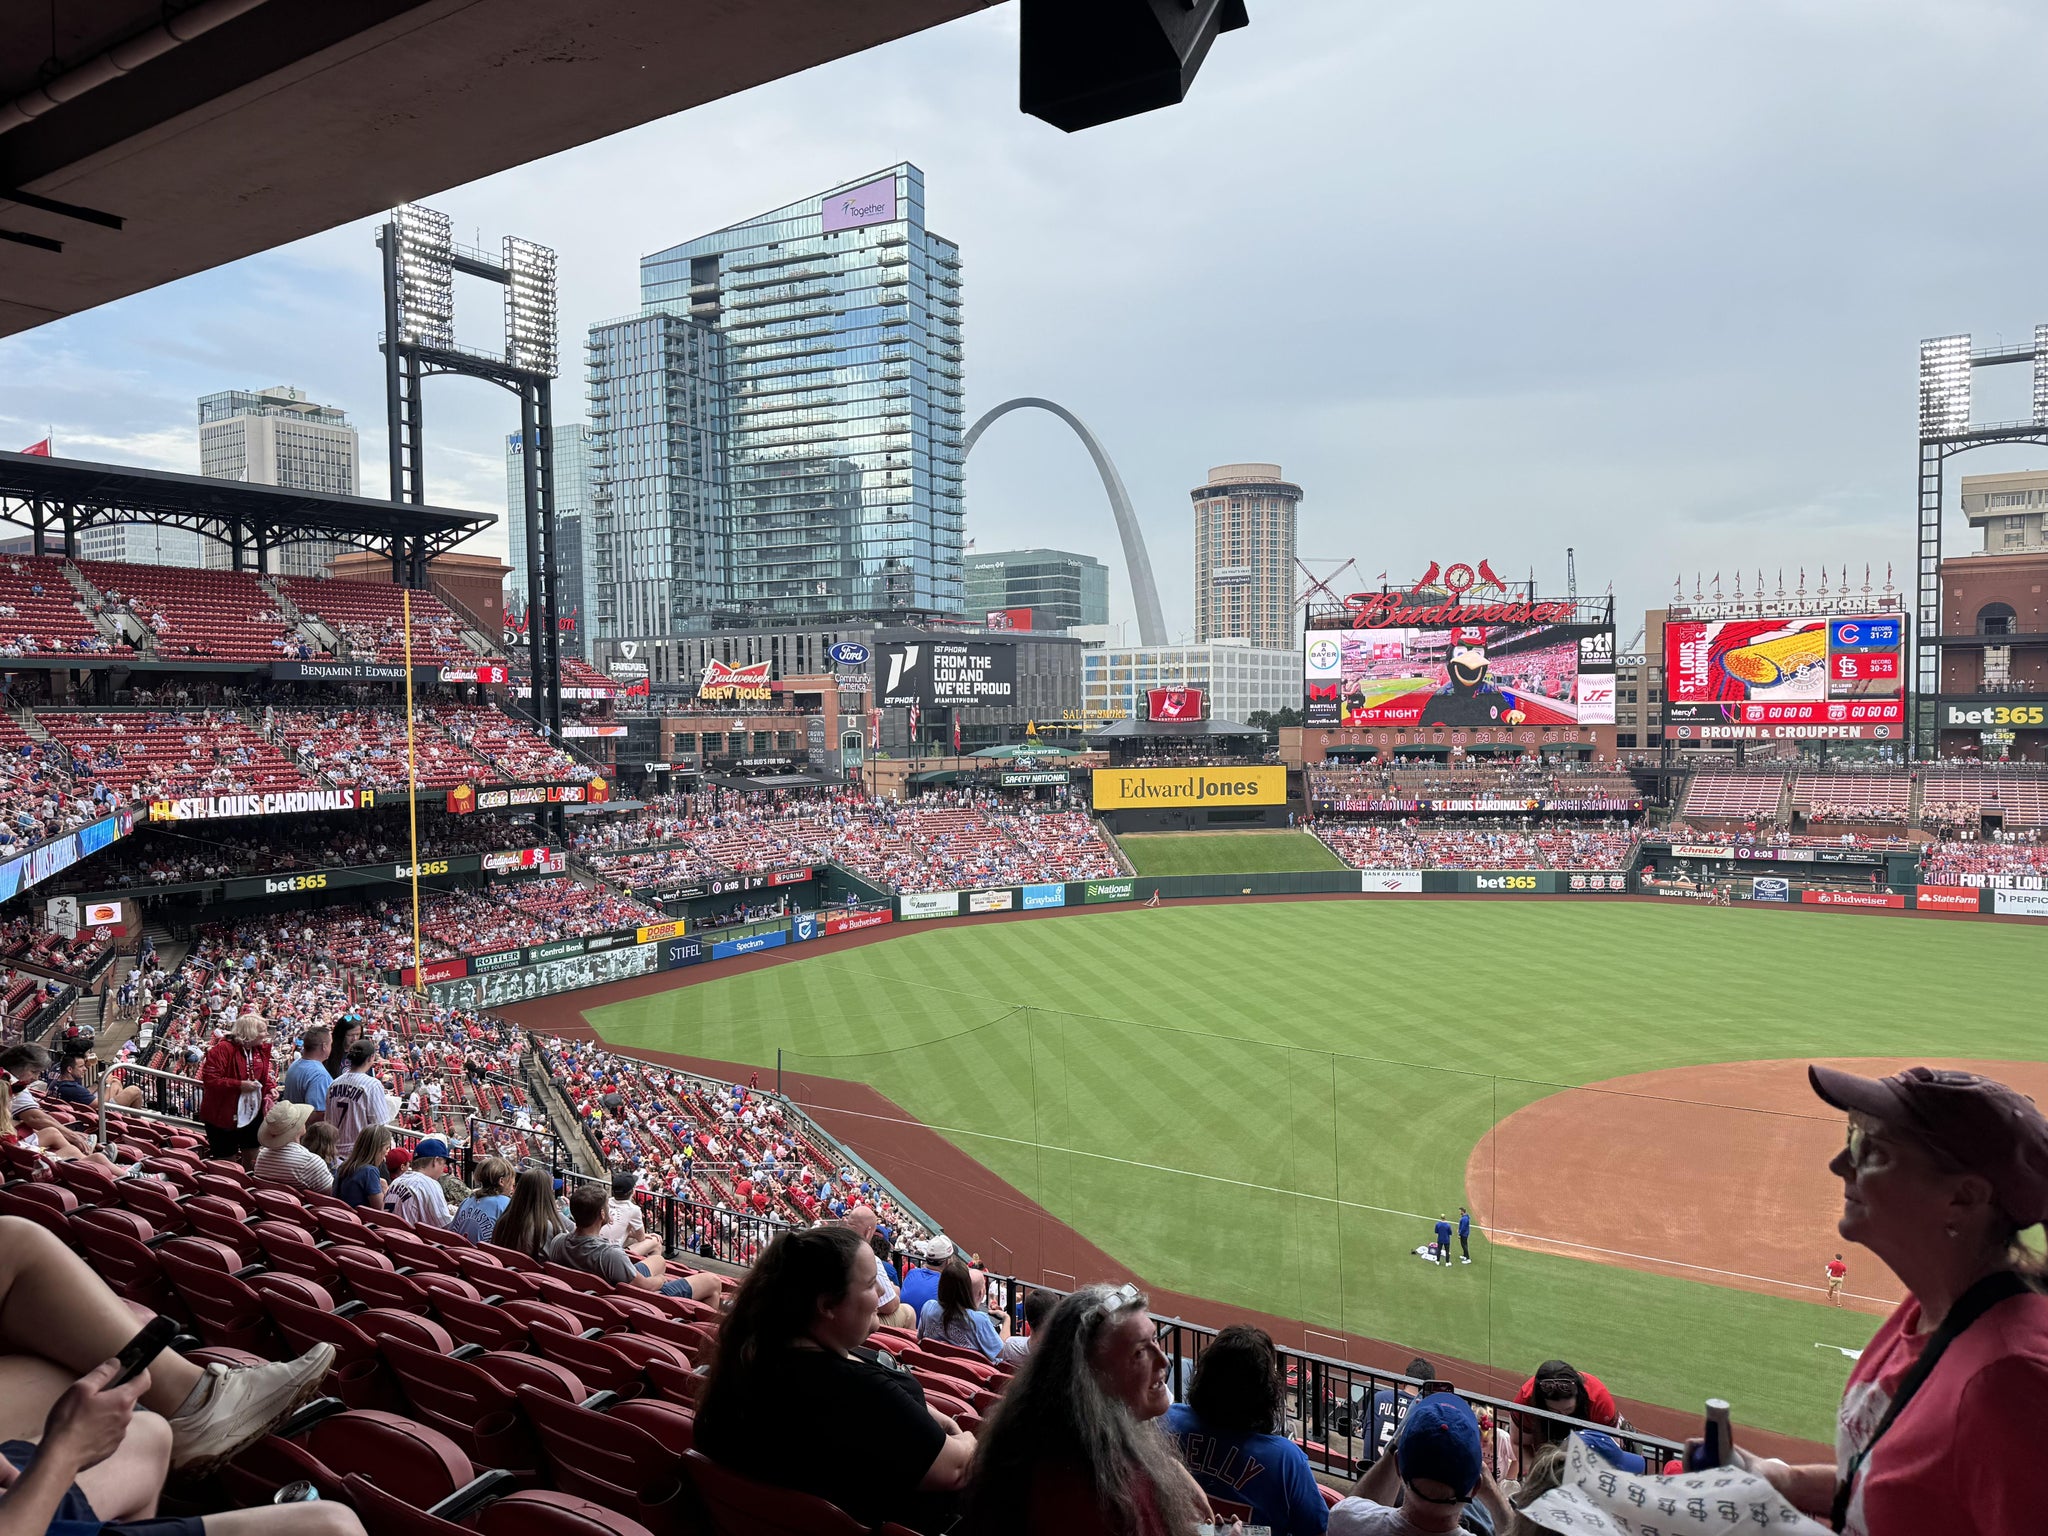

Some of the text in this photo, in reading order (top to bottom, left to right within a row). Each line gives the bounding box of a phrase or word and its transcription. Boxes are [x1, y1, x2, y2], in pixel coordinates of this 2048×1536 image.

[850, 204, 885, 218] Together
[1343, 592, 1578, 630] Budweiser
[1690, 598, 1880, 616] WORLD CHAMPIONS
[838, 645, 863, 661] Ford
[1680, 642, 1695, 674] LOUIS
[1695, 631, 1709, 687] CARDINALS
[934, 655, 988, 669] FROM THE
[300, 664, 357, 678] BENJAMIN
[365, 665, 413, 679] EDWARD
[440, 666, 478, 684] Cardinals
[701, 667, 770, 685] Budweiser
[934, 669, 984, 682] LOU AND
[578, 687, 606, 699] FOR THE
[701, 687, 772, 700] BREW HOUSE
[934, 682, 1011, 695] WE'RE PROUD
[1063, 708, 1127, 720] SALT SMOKE
[1353, 709, 1419, 719] LAST NIGHT
[1671, 707, 1692, 718] Mercy
[1768, 707, 1781, 718] GO
[1783, 707, 1797, 718] GO
[1798, 707, 1813, 718] GO
[1851, 706, 1865, 717] GO
[1867, 706, 1880, 717] GO
[1883, 706, 1897, 717] GO
[1948, 706, 2044, 724] bet365
[1701, 726, 1756, 738] BROWN
[1761, 728, 1770, 737] &
[1774, 726, 1860, 738] CROUPPEN
[1980, 732, 2016, 740] bet365
[1005, 773, 1066, 784] SAFETY NATIONAL
[1119, 776, 1259, 800] Edward Jones
[208, 793, 262, 817] LOUIS
[263, 789, 355, 814] CARDINALS
[1334, 799, 1415, 811] BUSCH STADIUM
[1447, 799, 1528, 811] LOUIS CARDINALS
[1582, 799, 1628, 811] STADIUM
[1676, 845, 1729, 855] Schnucks
[1754, 850, 1773, 858] 6:05
[1822, 852, 1840, 861] Mercy
[483, 853, 520, 870] Cardinals
[782, 871, 804, 881] PURINA
[1476, 875, 1537, 889] bet365
[1960, 873, 1986, 887] FOR
[1987, 874, 2013, 889] THE
[265, 875, 328, 894] bet365
[724, 882, 739, 891] 6:05
[1097, 883, 1132, 896] National
[1759, 880, 1781, 889] Ford
[1659, 889, 1683, 897] BUSCH
[1833, 894, 1888, 905] Budweiser
[1932, 894, 1977, 905] State Farm
[647, 924, 676, 937] DOBBS
[849, 917, 882, 932] Budweiser
[539, 943, 584, 958] Central Bank
[669, 944, 702, 962] STIFEL
[736, 940, 763, 953] Spectrum
[477, 952, 519, 966] ROTTLER
[491, 961, 520, 971] SOLUTIONS
[329, 1083, 364, 1103] SWANSON
[336, 1101, 349, 1128] 7
